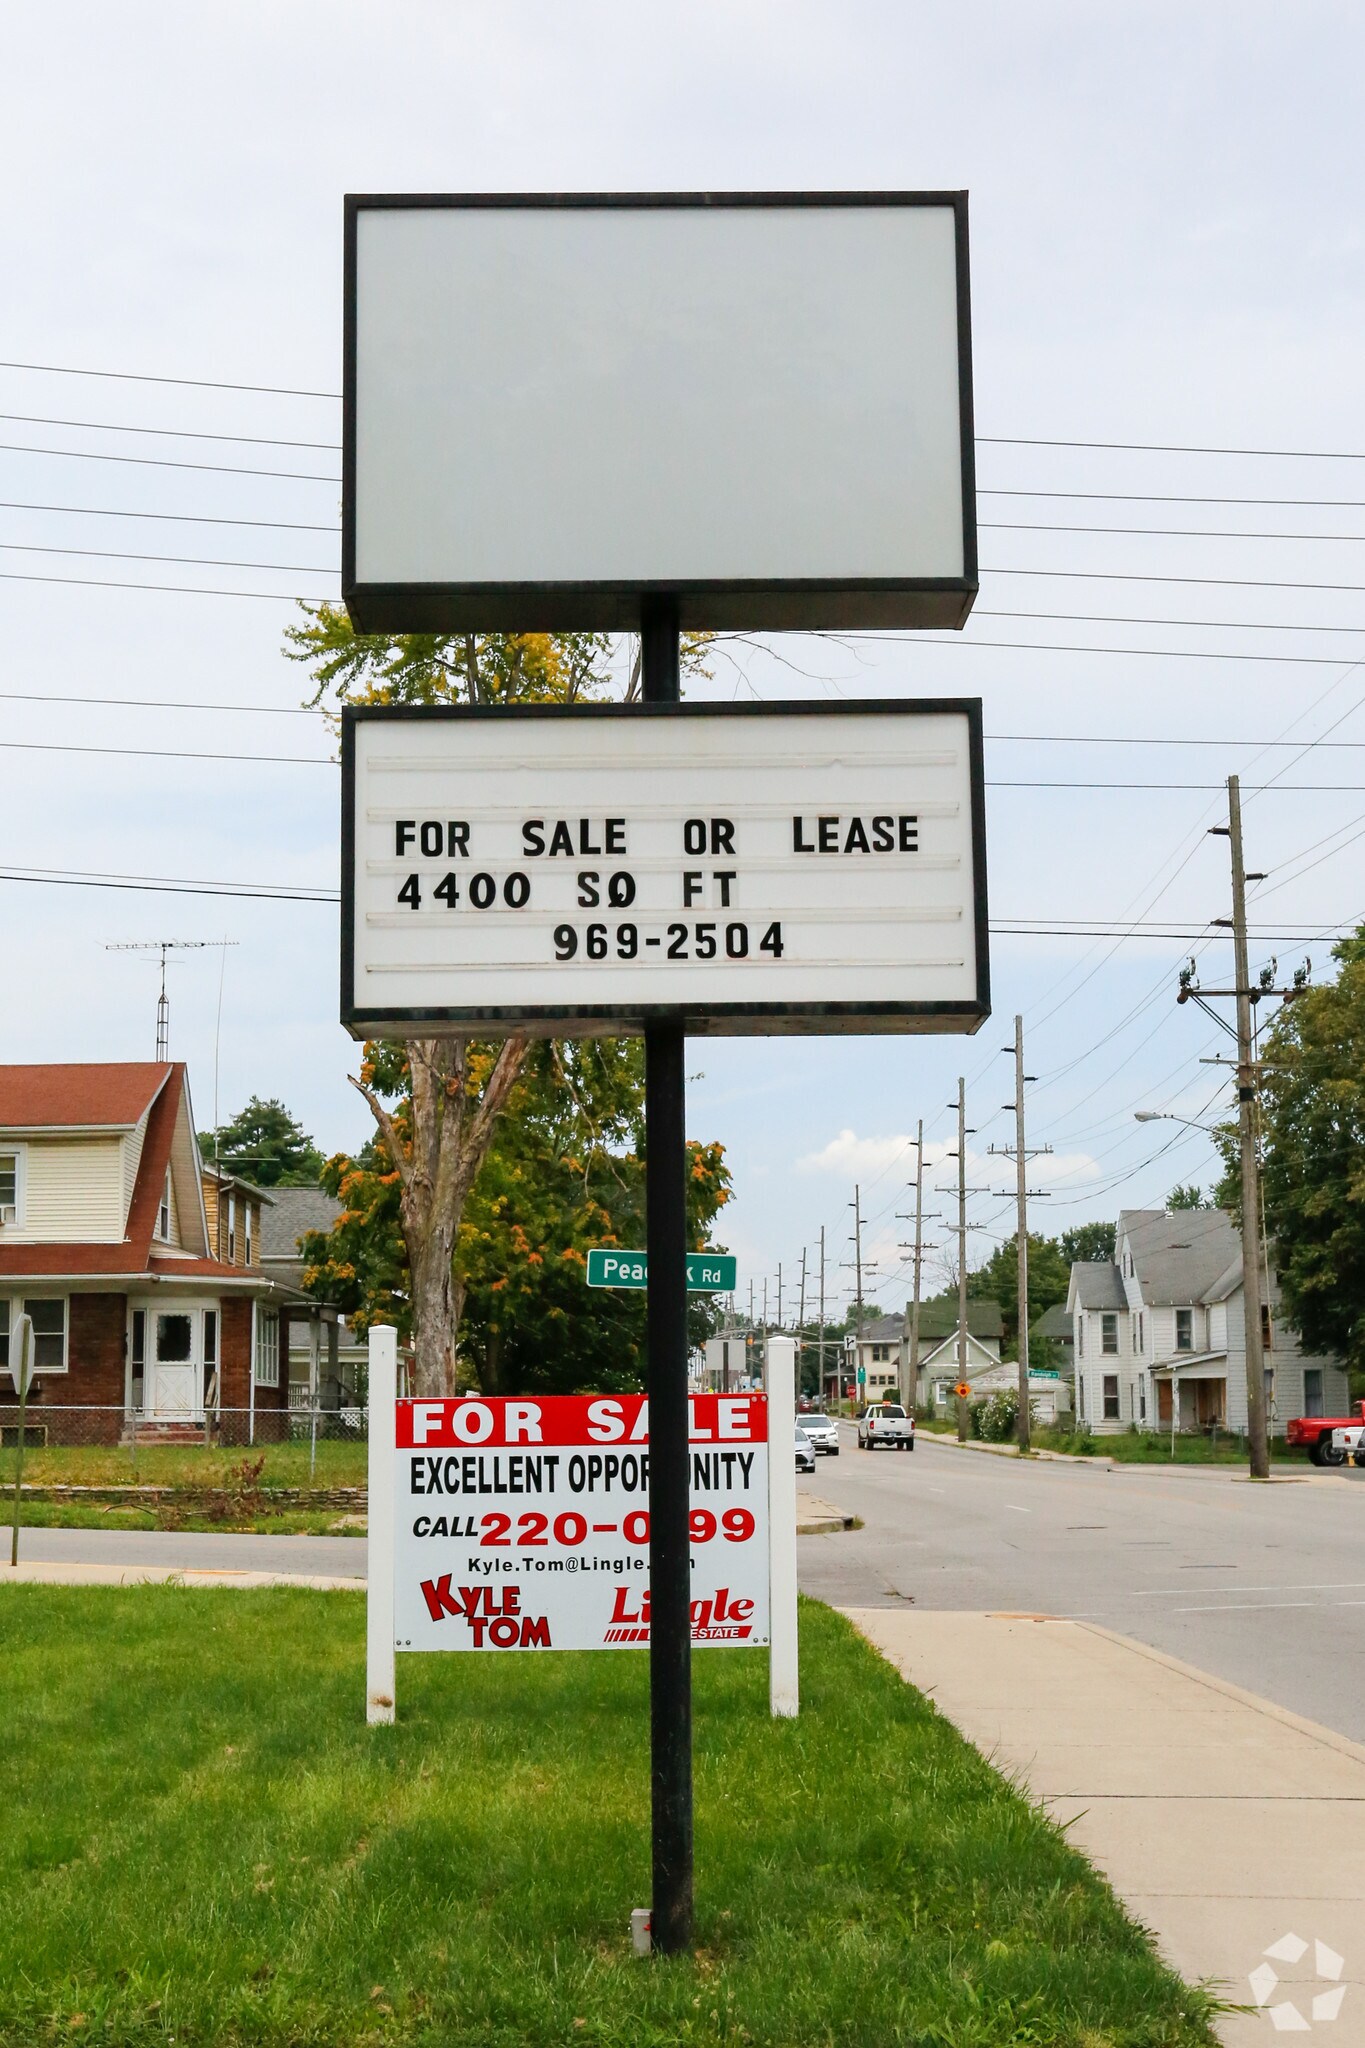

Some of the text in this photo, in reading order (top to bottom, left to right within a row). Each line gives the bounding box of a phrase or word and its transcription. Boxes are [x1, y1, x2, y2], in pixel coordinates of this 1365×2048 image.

[395, 815, 919, 857] FOR SALE OR LEASE
[397, 871, 737, 910] 4400 SQ FT
[553, 921, 784, 961] 969-2504
[603, 1258, 721, 1283] Peak Rd
[412, 1401, 543, 1444] FOR
[410, 1452, 755, 1495] EXCELLENT OPPORNITY
[412, 1507, 756, 1547] CALL 220-099
[468, 1556, 695, 1574] Kyle.Tom@Lingle.
[609, 1586, 755, 1630] Ligle
[468, 1616, 552, 1648] TOM
[690, 1627, 740, 1639] ESTATE
